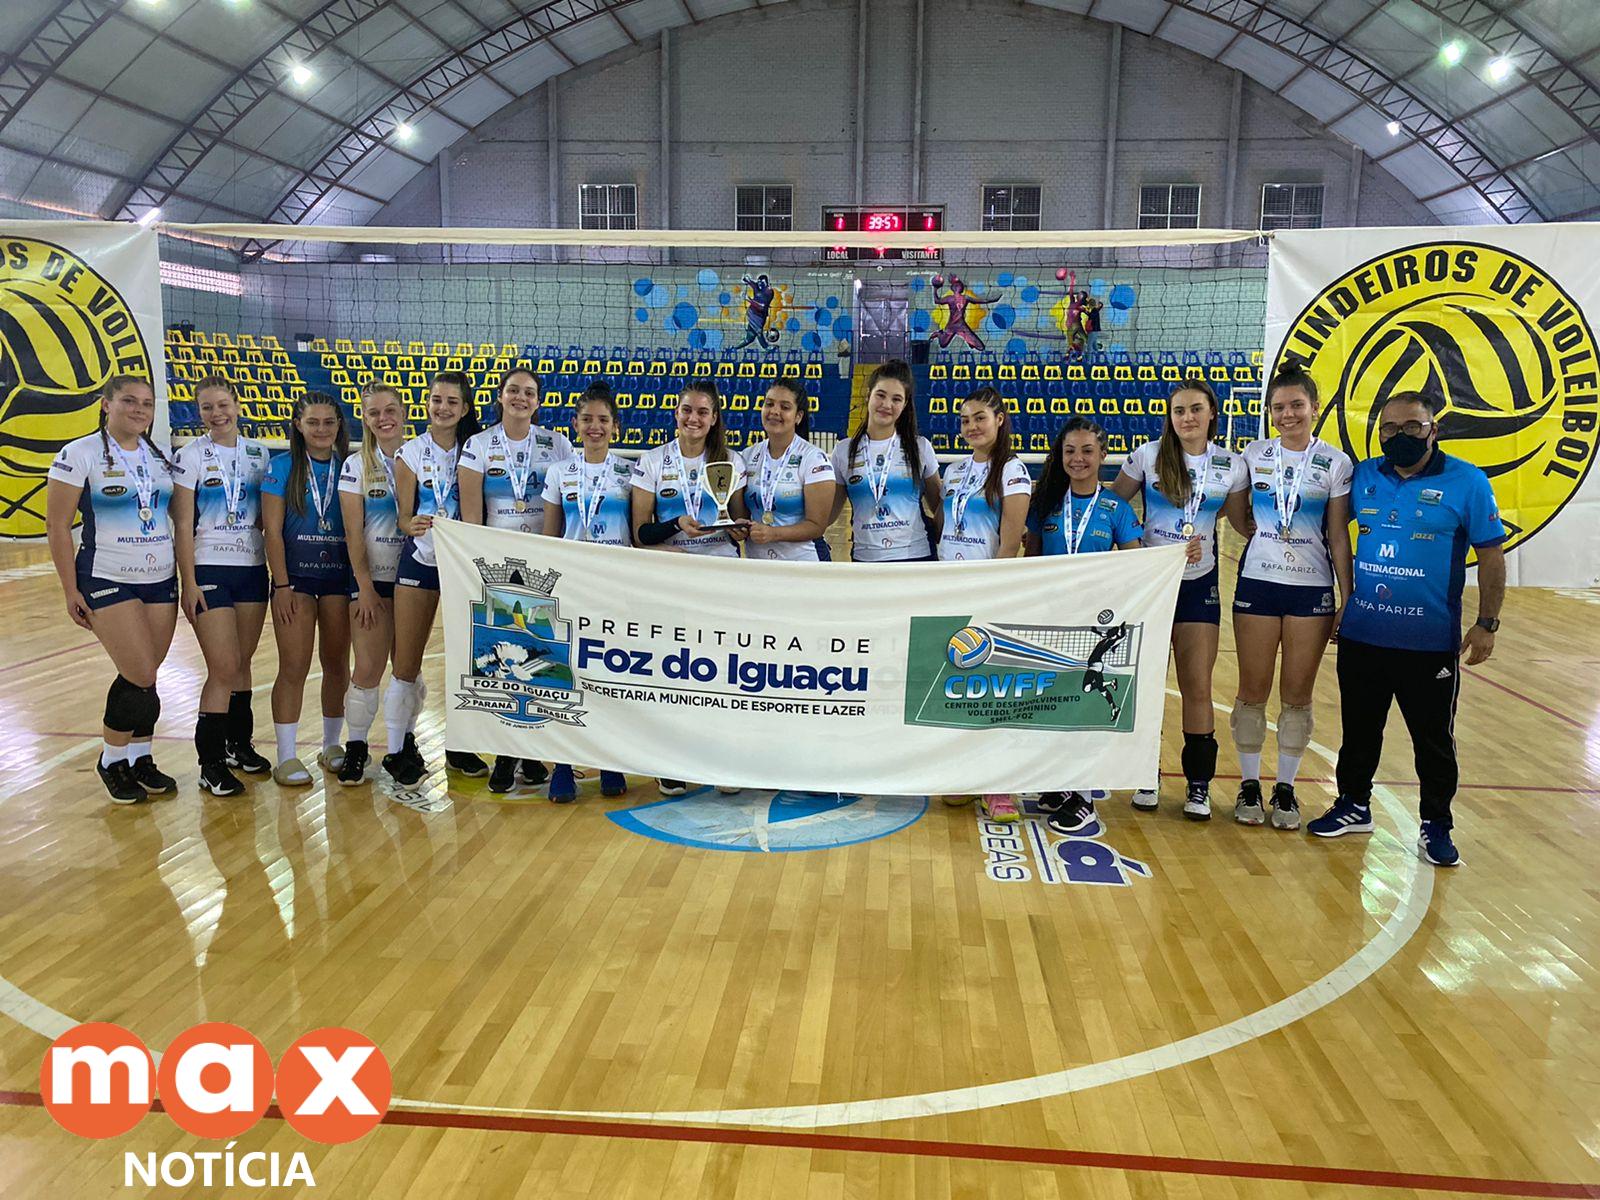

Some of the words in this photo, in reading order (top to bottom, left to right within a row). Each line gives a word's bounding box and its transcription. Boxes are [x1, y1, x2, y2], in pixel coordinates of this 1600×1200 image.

[868, 215, 899, 229] 39:57
[827, 251, 848, 259] LOCAL
[901, 250, 938, 260] VISITANTE
[40, 250, 84, 294] DE
[1283, 249, 1479, 369] LINDEIROS
[1489, 259, 1544, 308] DE
[1536, 298, 1600, 481] VOLEIBOL
[672, 536, 726, 546] MULTINACIONAL
[1378, 543, 1395, 558] M
[1261, 562, 1283, 571] RAFA
[1285, 565, 1317, 575] PARIZE
[1378, 603, 1424, 616] PARIZE
[578, 616, 803, 652] PREFEITURA
[830, 638, 870, 654] DE
[577, 637, 654, 677] Foz
[661, 647, 718, 683] do
[727, 653, 870, 696] Iguaçu
[473, 679, 499, 689] FOZ
[502, 682, 520, 691] DO
[523, 684, 570, 701] IGUAÇU
[944, 671, 1058, 700] CDVFF
[472, 699, 513, 710] PARANÁ
[581, 681, 656, 702] SECRETARIA
[659, 692, 728, 710] MUNICIPAL
[731, 699, 749, 710] DE
[751, 701, 809, 714] ESPORTE
[812, 704, 820, 715] E
[823, 704, 866, 717] LAZER
[982, 701, 993, 709] DE
[996, 695, 1081, 709] DESENVOLVIMENTO
[536, 706, 570, 720] BRASIL
[967, 709, 1010, 717] VOLEIBOL
[1012, 704, 1057, 714] FEMININO
